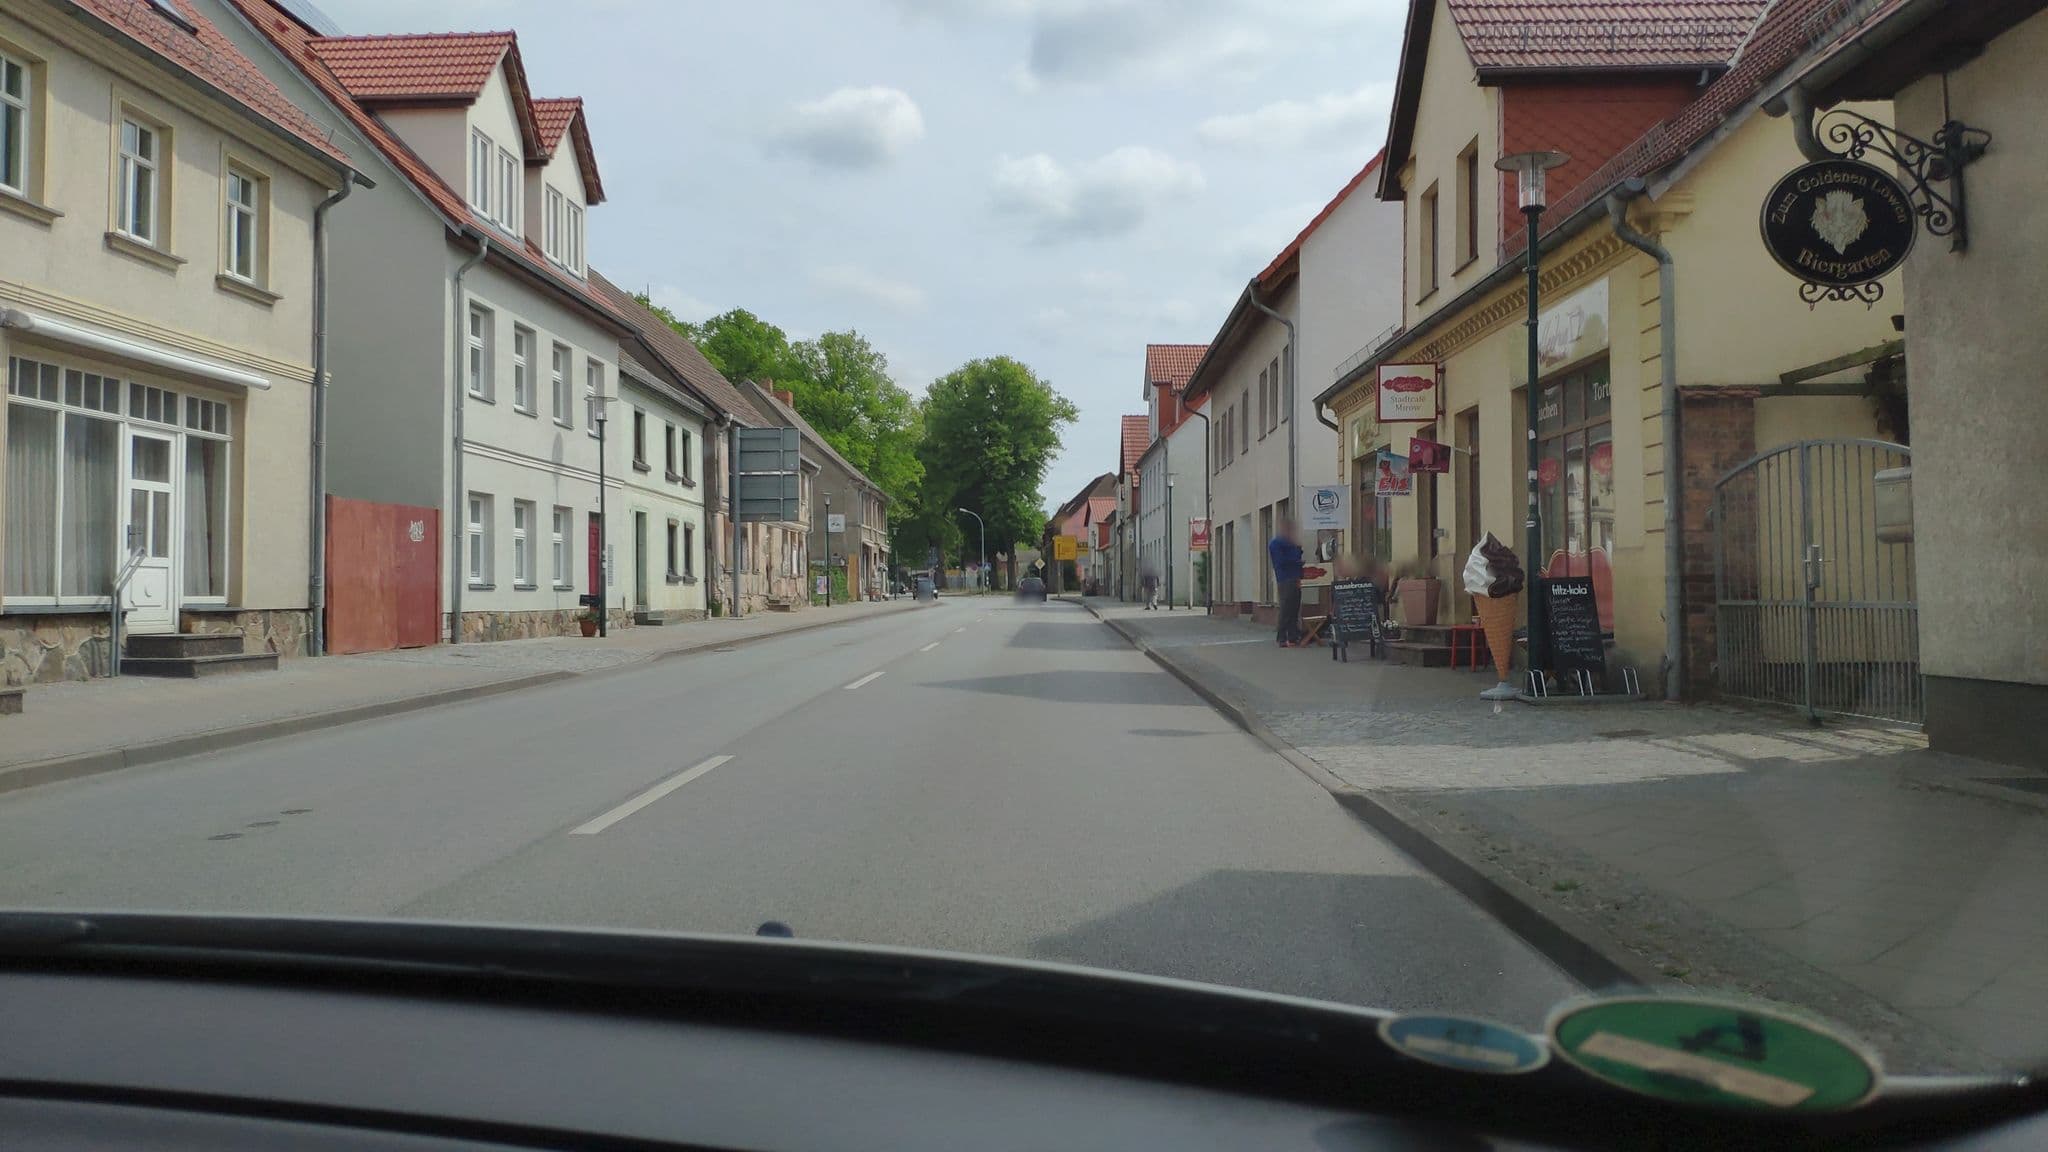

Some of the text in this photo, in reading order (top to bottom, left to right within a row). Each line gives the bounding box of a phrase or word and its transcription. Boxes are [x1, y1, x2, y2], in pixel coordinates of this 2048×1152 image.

[1772, 191, 1799, 224] Zum
[1797, 169, 1867, 193] Goldenen
[1798, 248, 1890, 279] Biergarten
